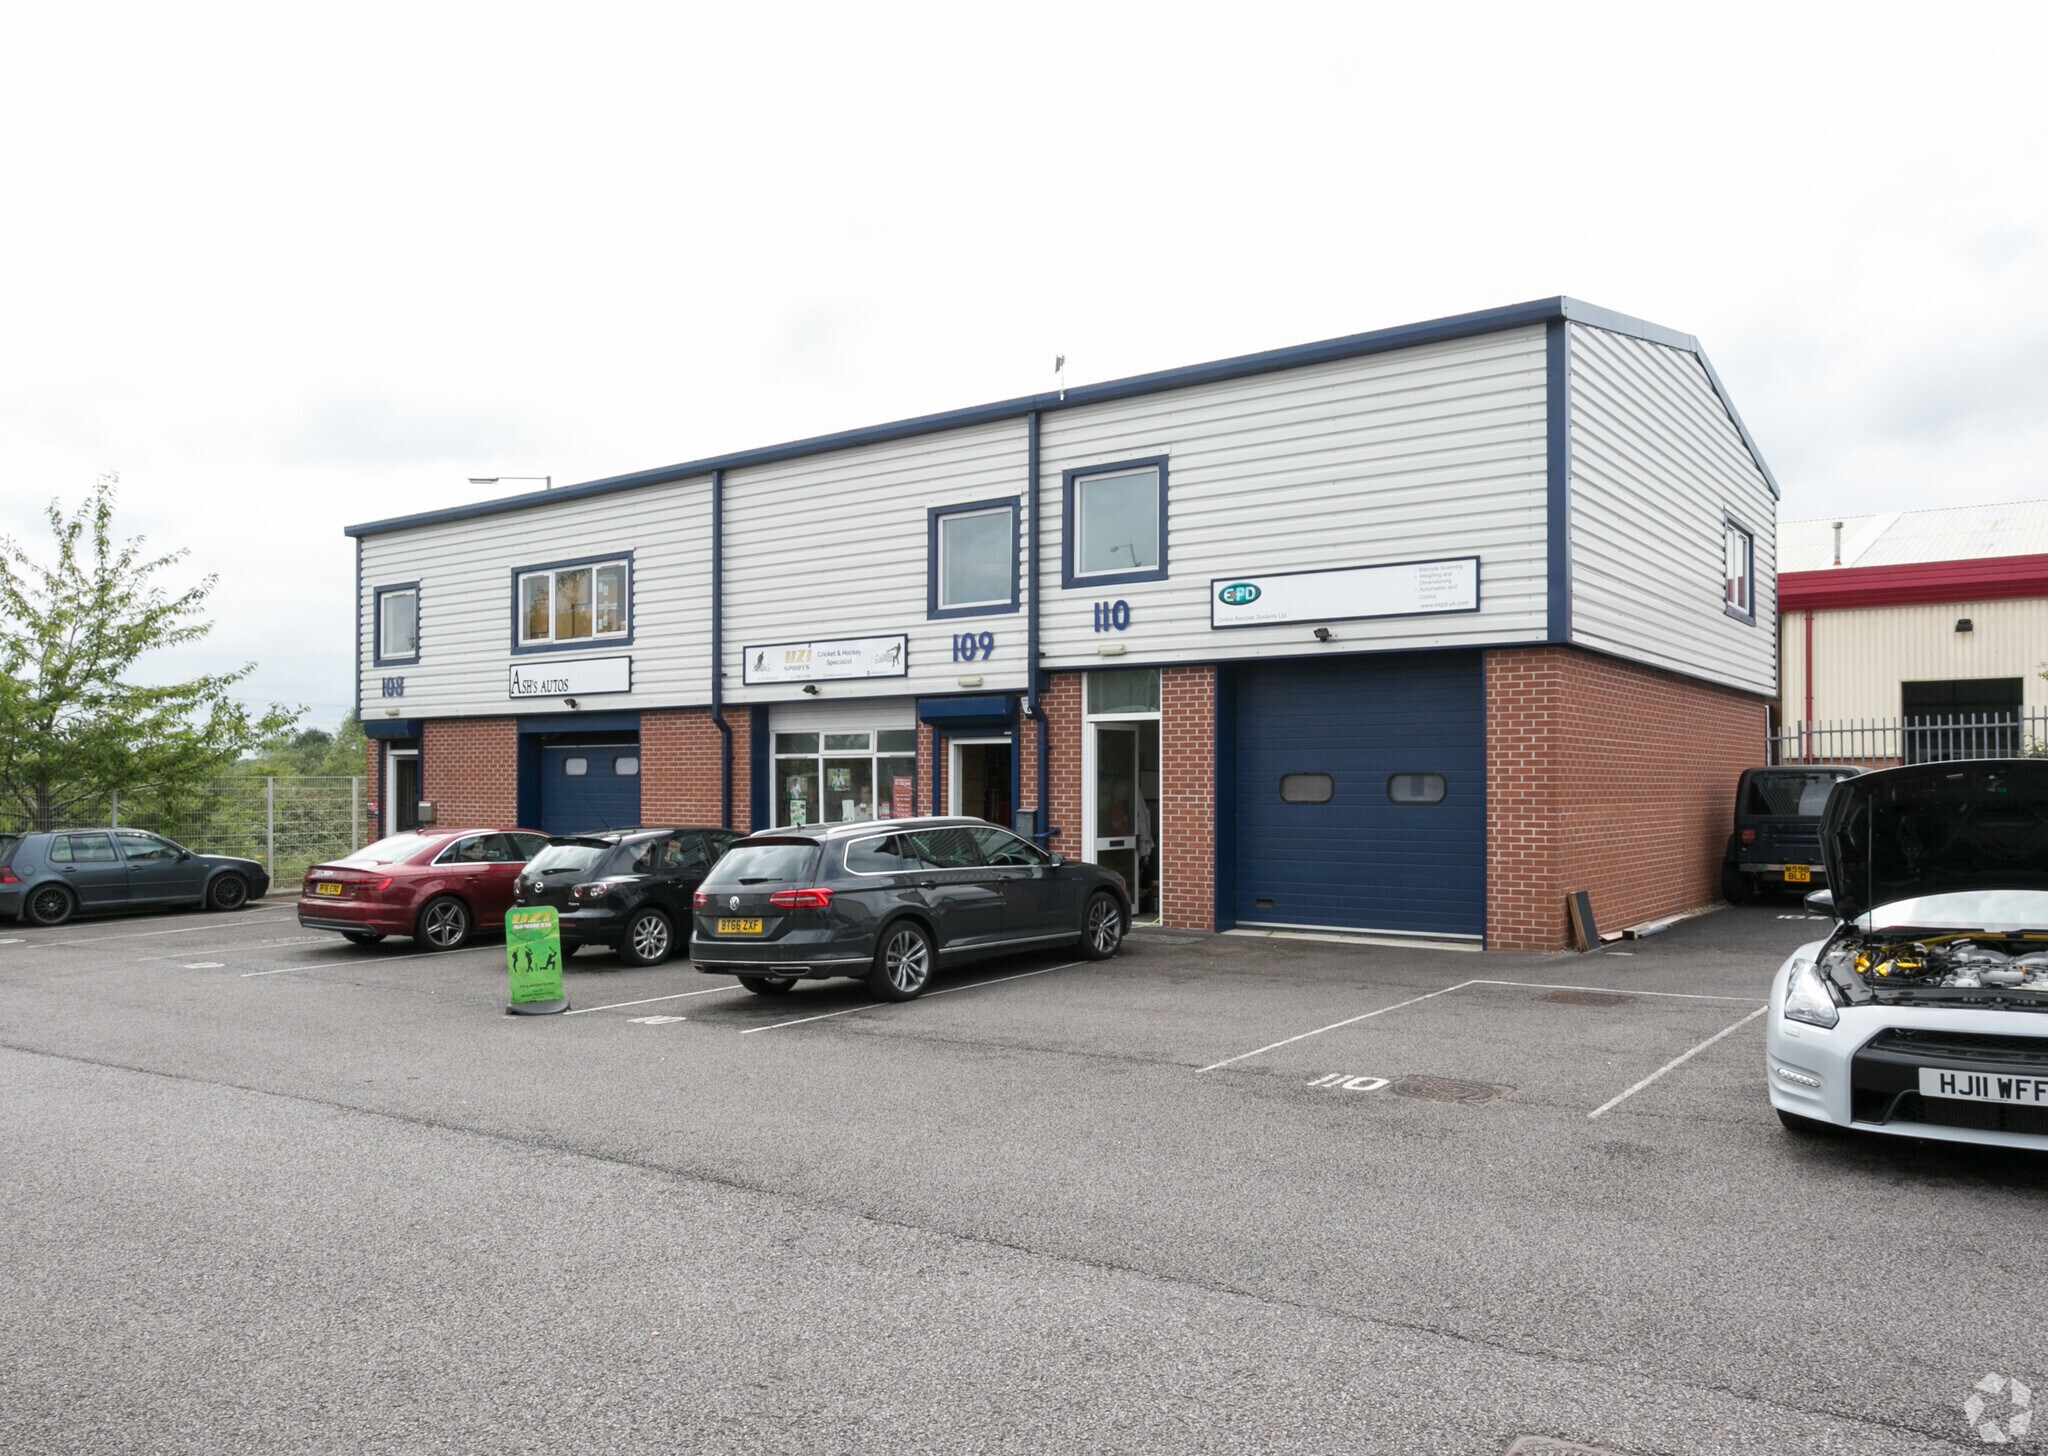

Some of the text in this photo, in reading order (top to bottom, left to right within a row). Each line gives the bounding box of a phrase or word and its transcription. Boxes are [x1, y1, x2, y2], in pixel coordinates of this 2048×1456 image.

[1094, 599, 1131, 633] 110
[817, 650, 836, 658] Cricket
[842, 648, 862, 656] Hockey
[953, 631, 995, 663] 109
[826, 658, 853, 666] Specialist
[382, 676, 405, 698] 108
[540, 678, 569, 693] AUTOS
[721, 919, 760, 931] BT66 ZXF
[1940, 1072, 2048, 1102] HJ11 WFF
